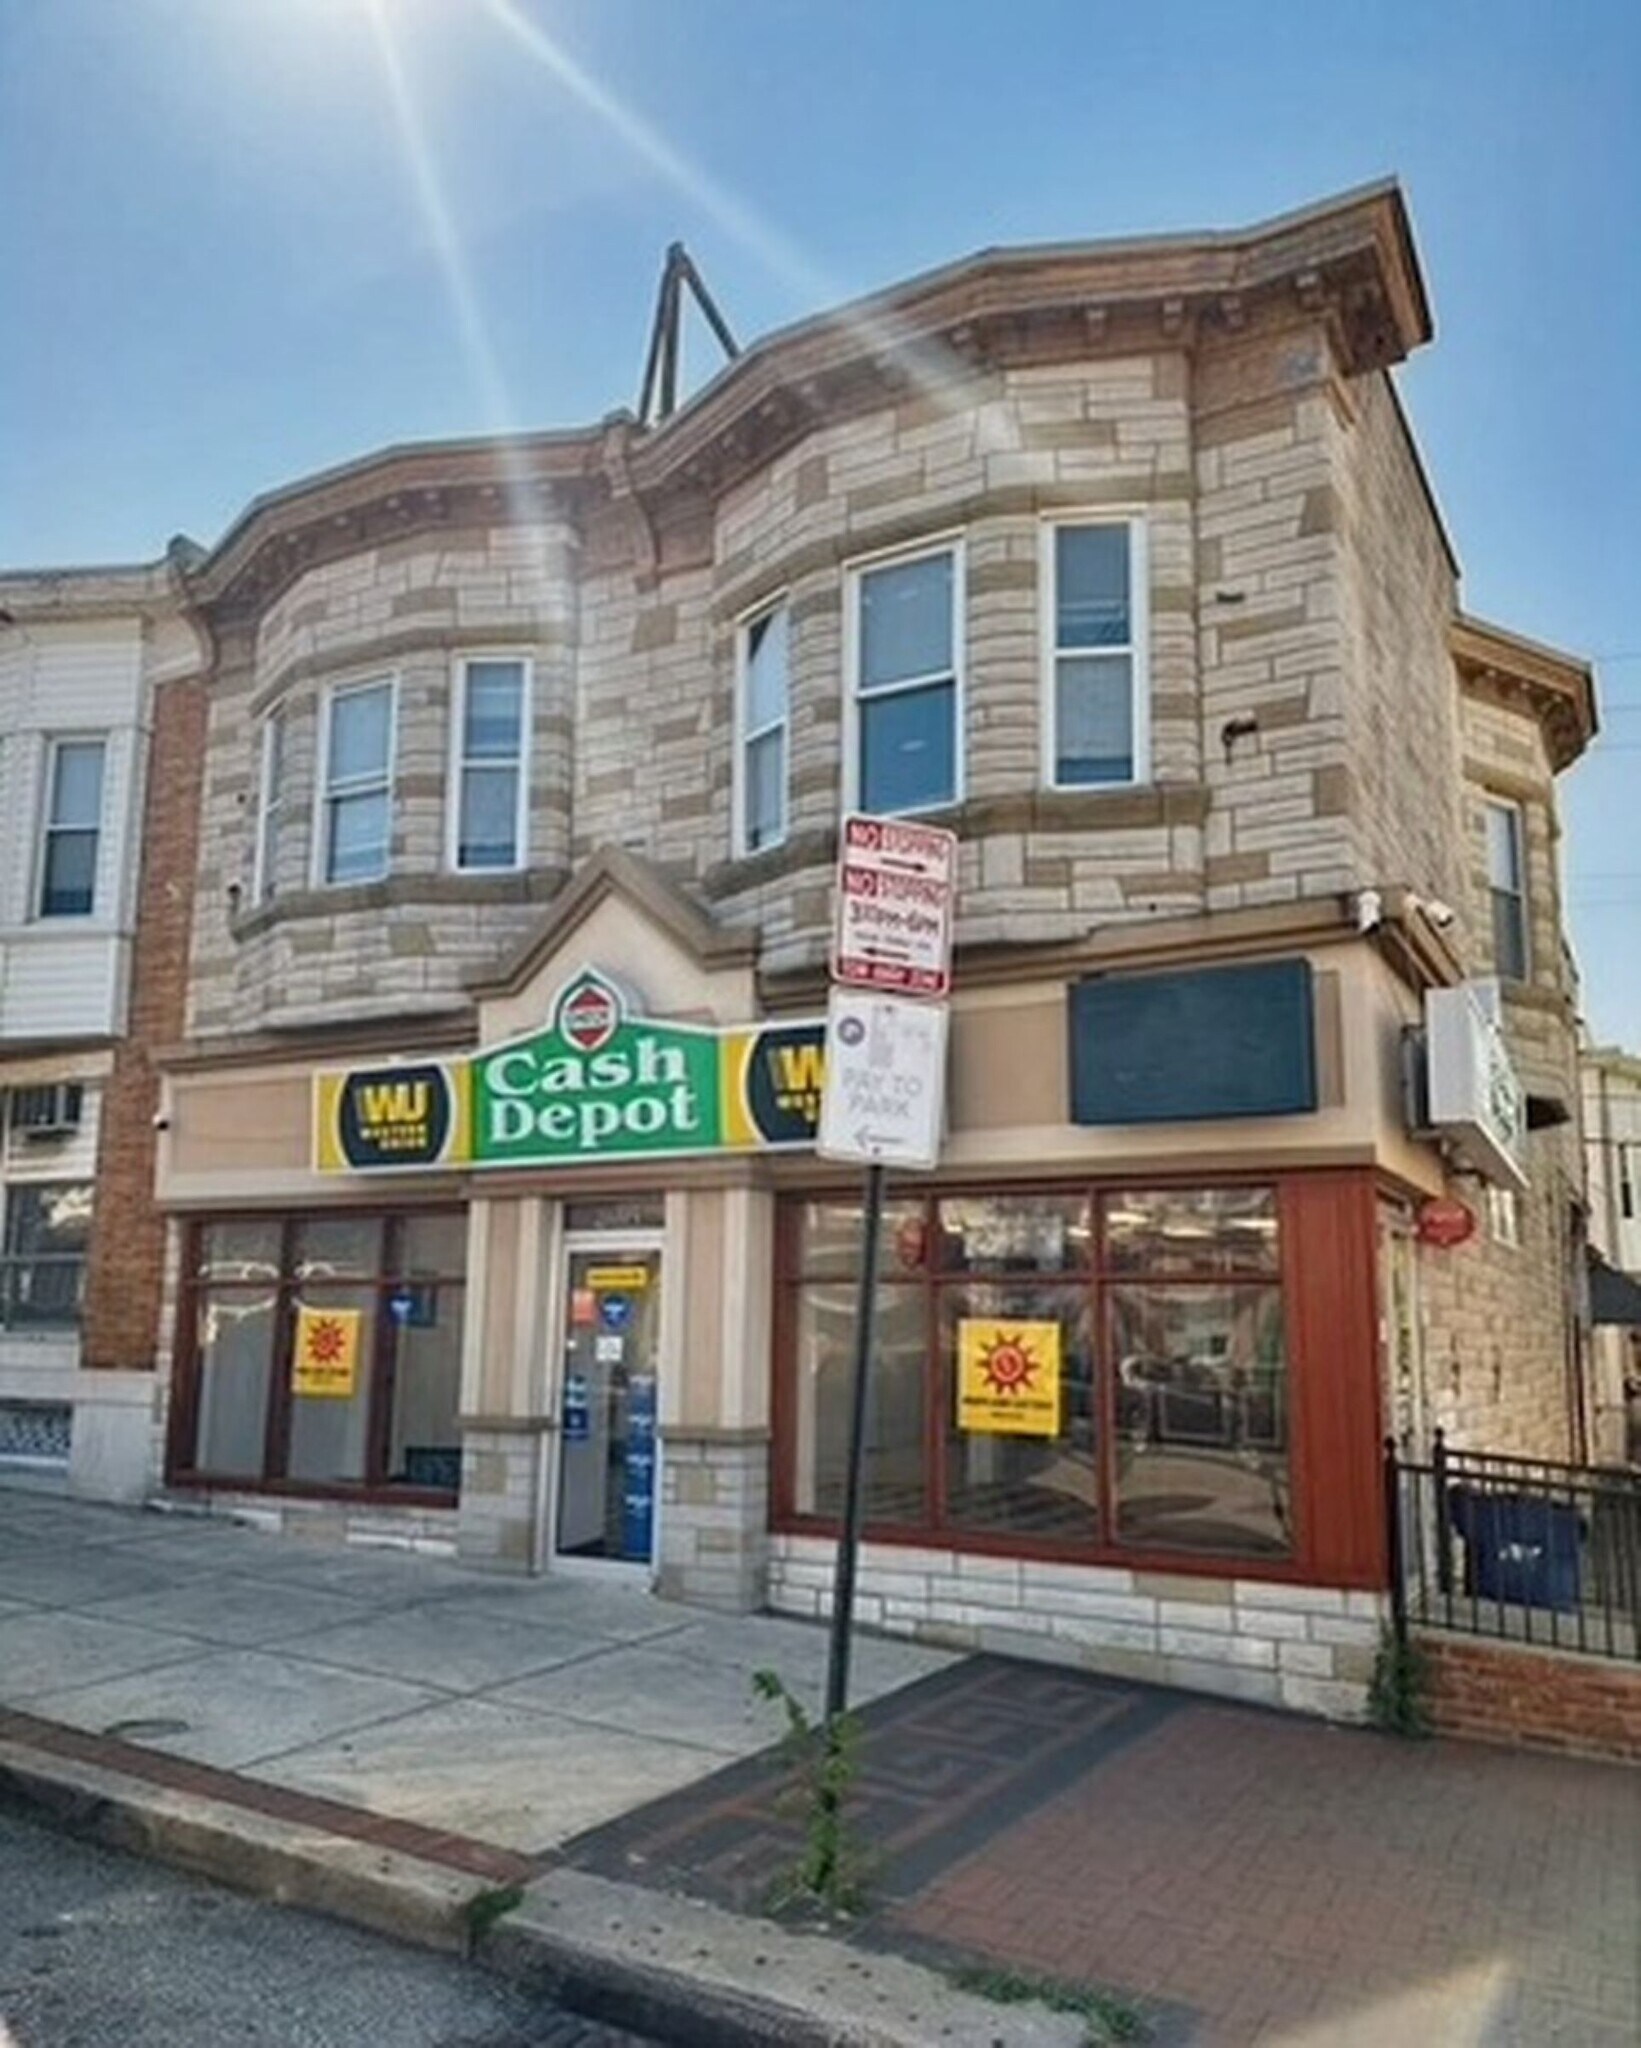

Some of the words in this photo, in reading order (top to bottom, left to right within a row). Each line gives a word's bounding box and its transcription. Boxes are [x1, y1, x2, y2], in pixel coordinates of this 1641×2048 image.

[849, 822, 879, 849] NO
[845, 868, 875, 895] NO
[484, 1037, 687, 1096] Cash
[842, 1066, 885, 1094] PAY
[893, 1073, 923, 1098] TO
[489, 1085, 699, 1149] Depot
[849, 1093, 911, 1120] PARK
